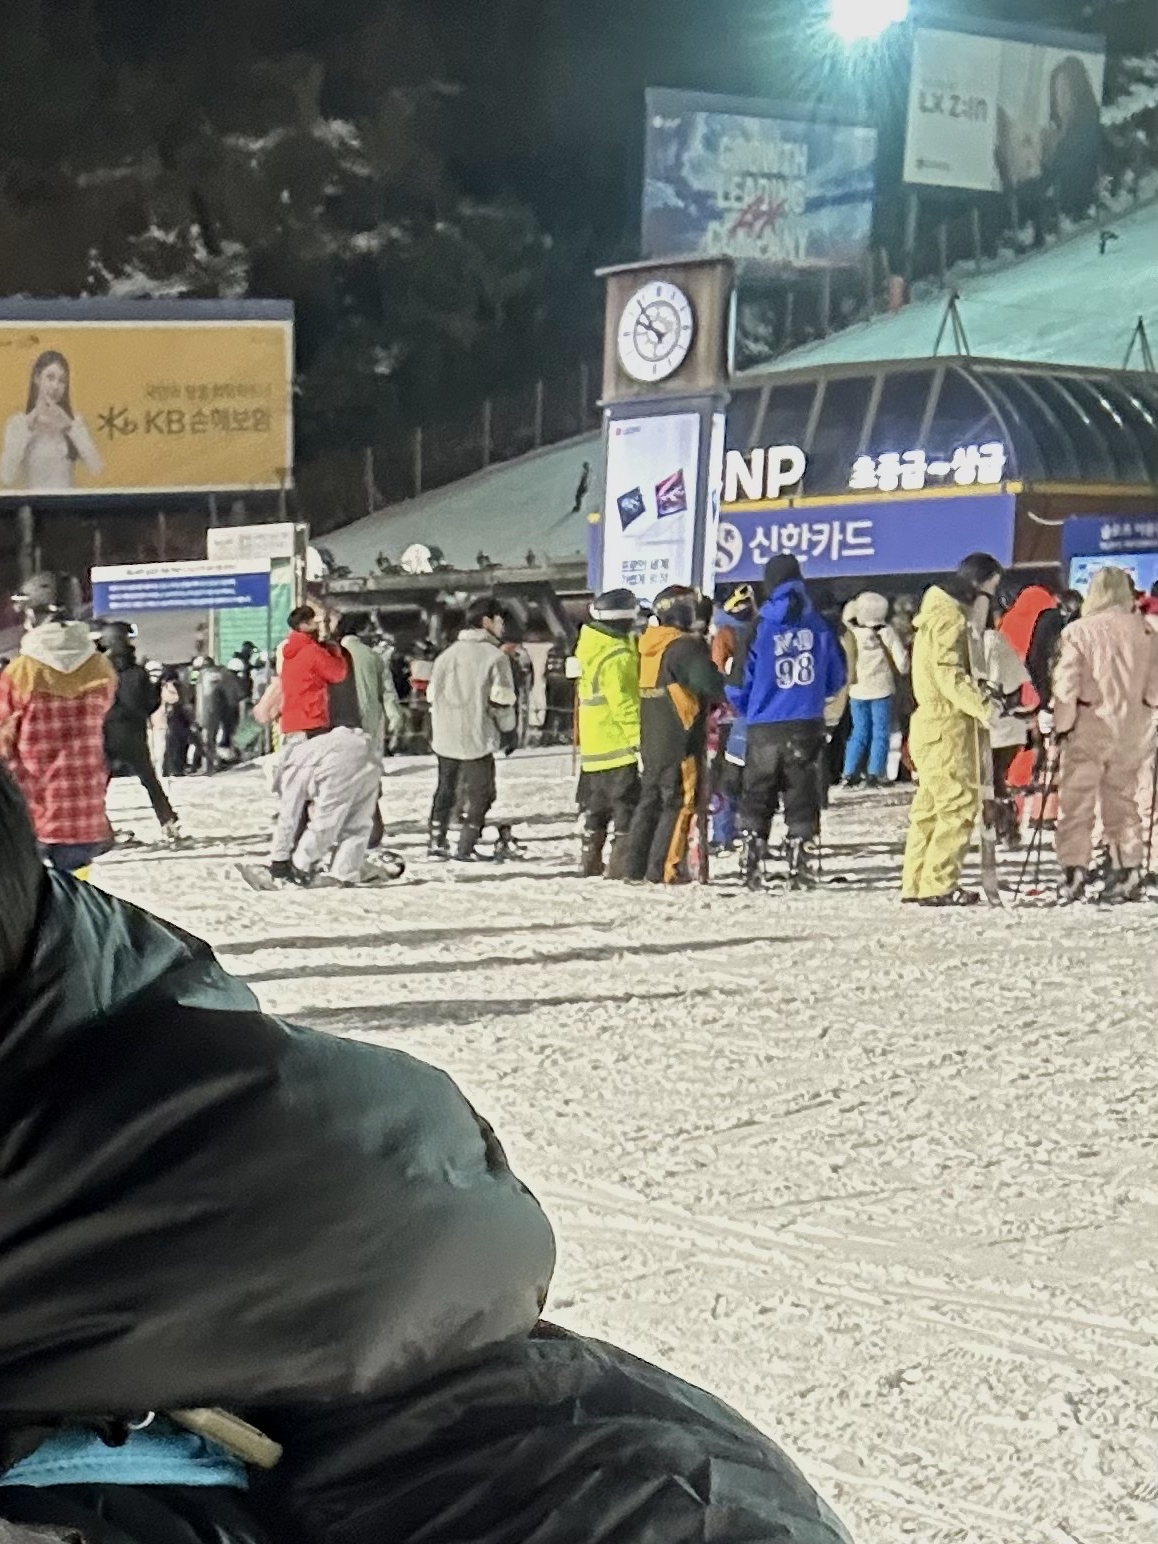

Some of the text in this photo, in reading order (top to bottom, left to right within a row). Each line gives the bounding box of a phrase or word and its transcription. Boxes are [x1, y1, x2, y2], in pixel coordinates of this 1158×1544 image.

[724, 445, 806, 502] NP
[749, 521, 875, 565] 신한카드
[775, 652, 815, 689] 98
